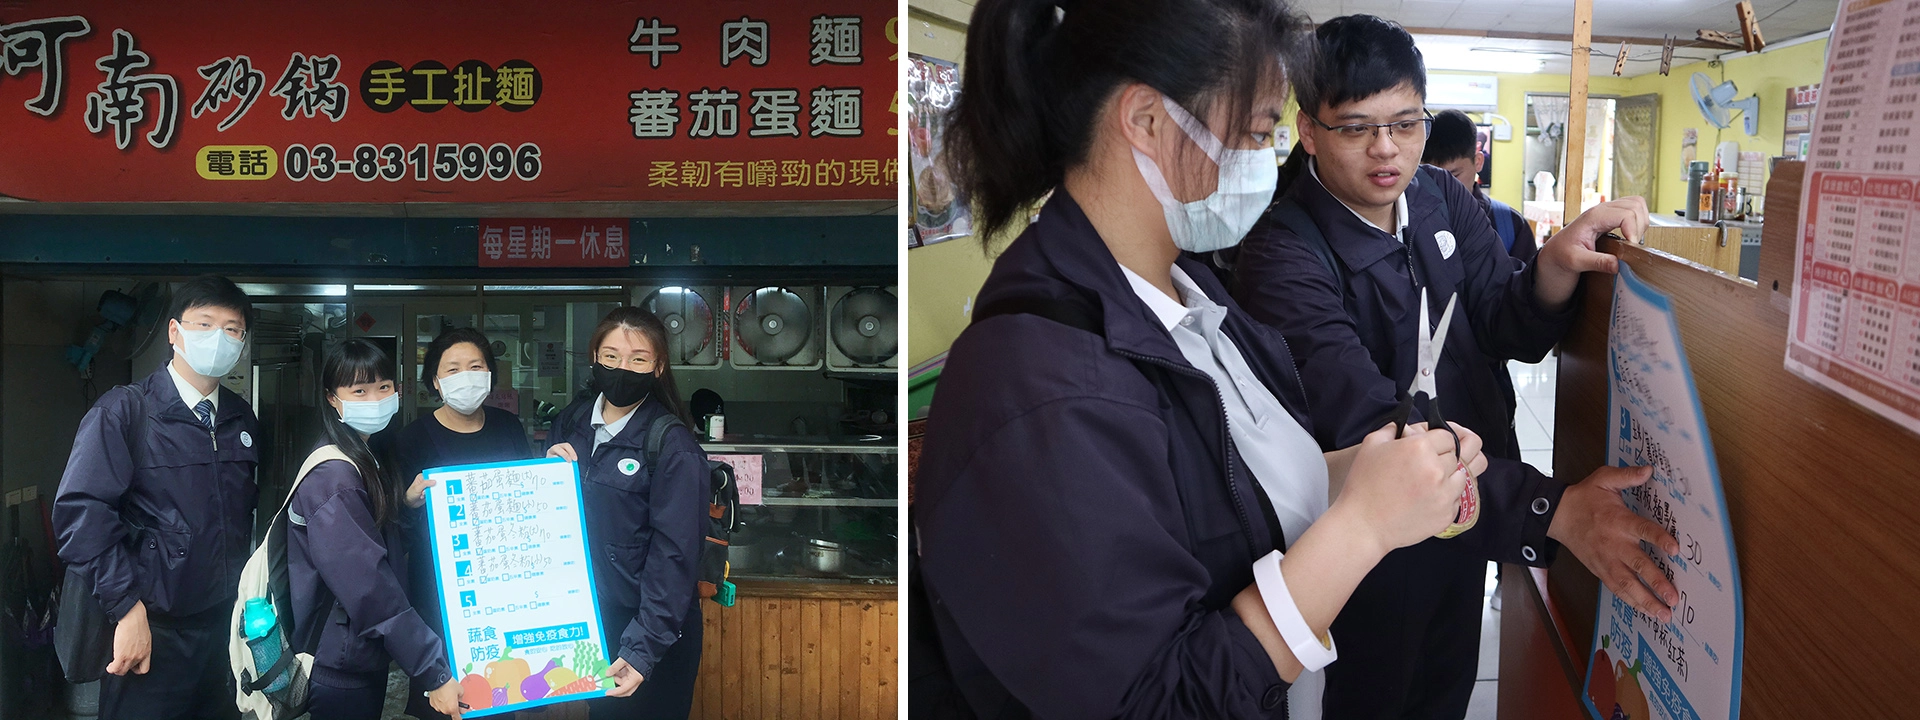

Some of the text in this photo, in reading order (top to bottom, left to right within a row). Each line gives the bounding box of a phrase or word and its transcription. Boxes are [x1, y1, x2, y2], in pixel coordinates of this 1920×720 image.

[628, 16, 863, 67] 牛肉麵
[628, 87, 863, 139] 蕃茄蛋麵
[205, 142, 542, 181] 電話 03-8315996
[482, 225, 626, 261] 每星期一休息
[1686, 533, 1703, 565] 30
[1681, 591, 1695, 626] 70
[467, 625, 498, 643] 蔬食
[512, 626, 584, 645] 增強免疫食力!
[1610, 614, 1633, 668] 防疫
[470, 643, 501, 662] 防疫
